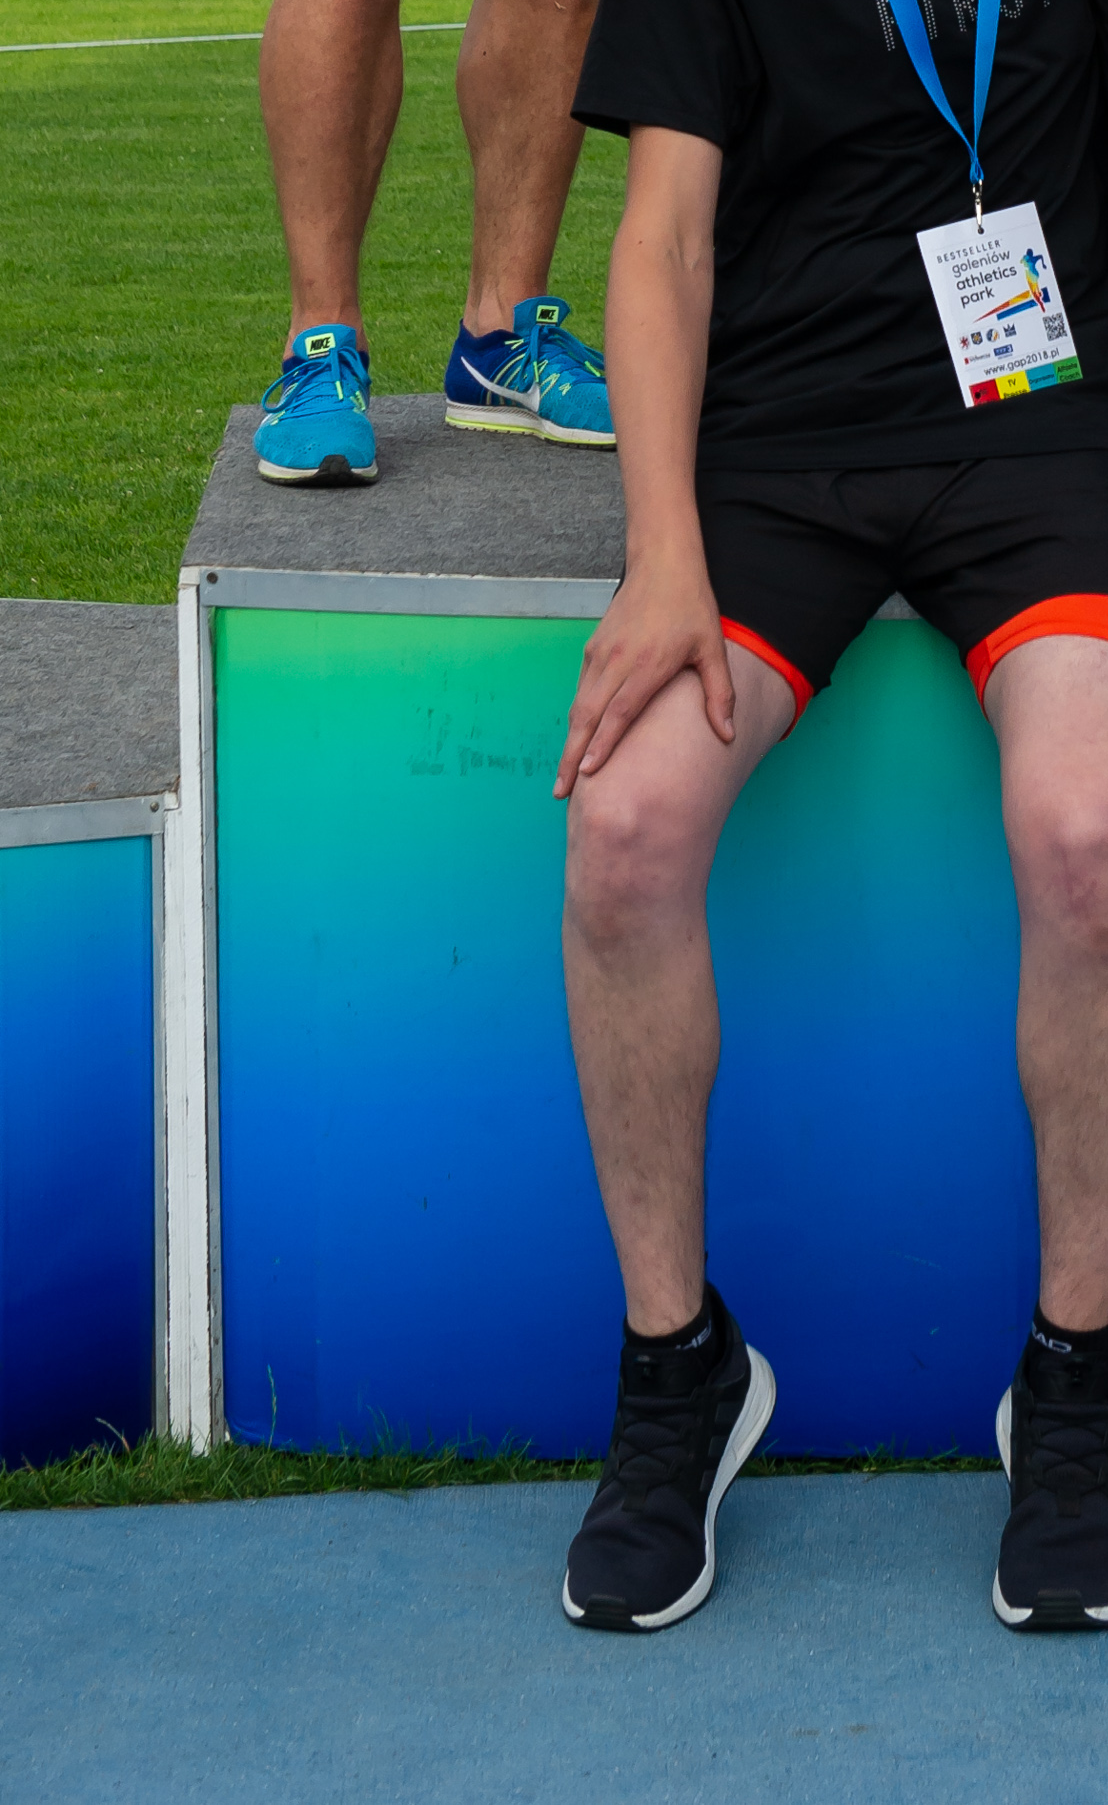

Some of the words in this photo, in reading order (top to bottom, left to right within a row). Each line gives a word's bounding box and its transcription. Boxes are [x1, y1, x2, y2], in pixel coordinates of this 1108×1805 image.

[937, 239, 1001, 264] BESTSELLER
[952, 250, 1010, 278] goleniów
[955, 266, 1017, 290] athletics
[960, 286, 995, 309] park
[309, 336, 331, 352] NIKE
[984, 347, 1060, 376] www.gap2018.pl
